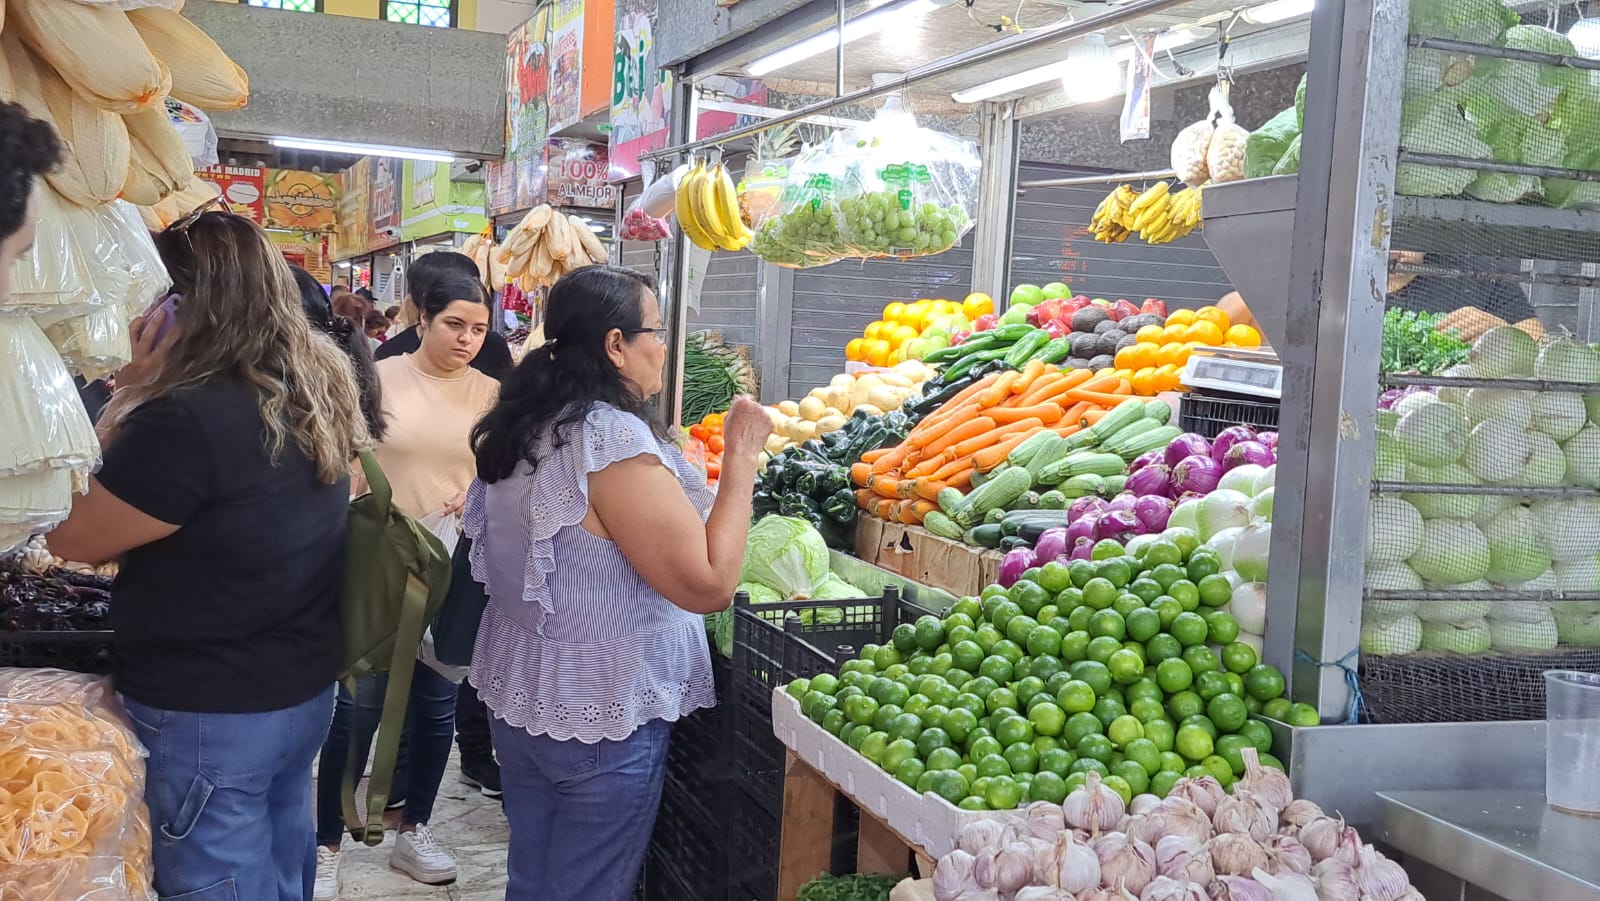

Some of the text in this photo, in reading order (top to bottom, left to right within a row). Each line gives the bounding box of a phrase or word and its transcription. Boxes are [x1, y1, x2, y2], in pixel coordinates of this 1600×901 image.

[224, 166, 260, 177] MADRID
[561, 159, 608, 181] 100%
[558, 183, 612, 199] AL MEJOR
